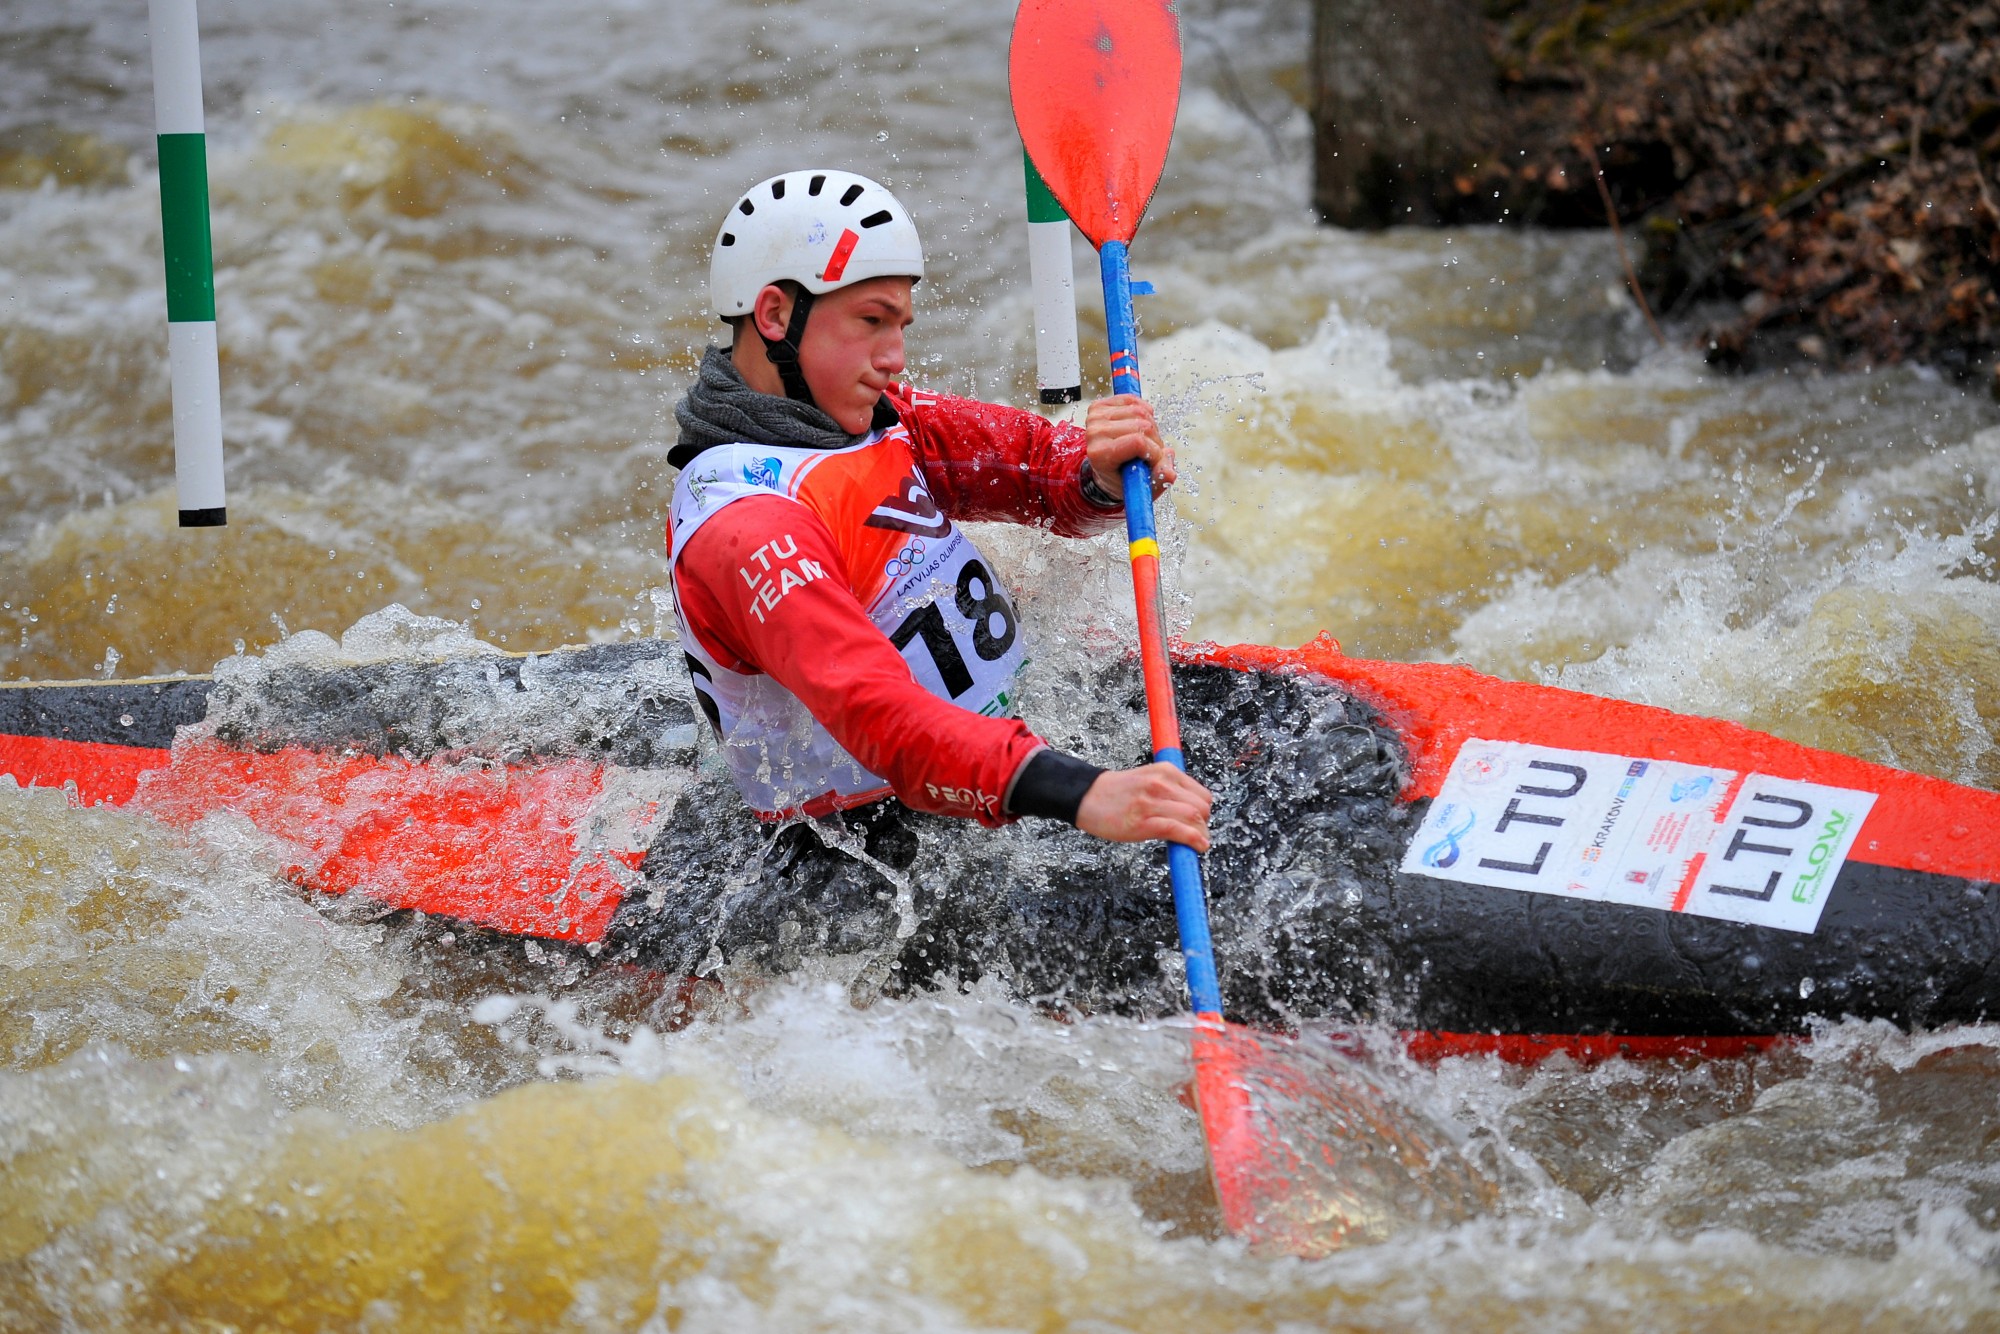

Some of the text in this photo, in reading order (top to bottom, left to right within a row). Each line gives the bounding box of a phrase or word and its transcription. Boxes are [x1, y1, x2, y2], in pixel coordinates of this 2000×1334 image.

[740, 534, 798, 590] LTU
[749, 558, 831, 624] TEAM
[896, 559, 940, 597] LATVIJAS
[889, 558, 1016, 700] 18
[1477, 759, 1588, 875] LTU
[1708, 792, 1814, 902] LTU
[1790, 809, 1845, 904] FLOW
